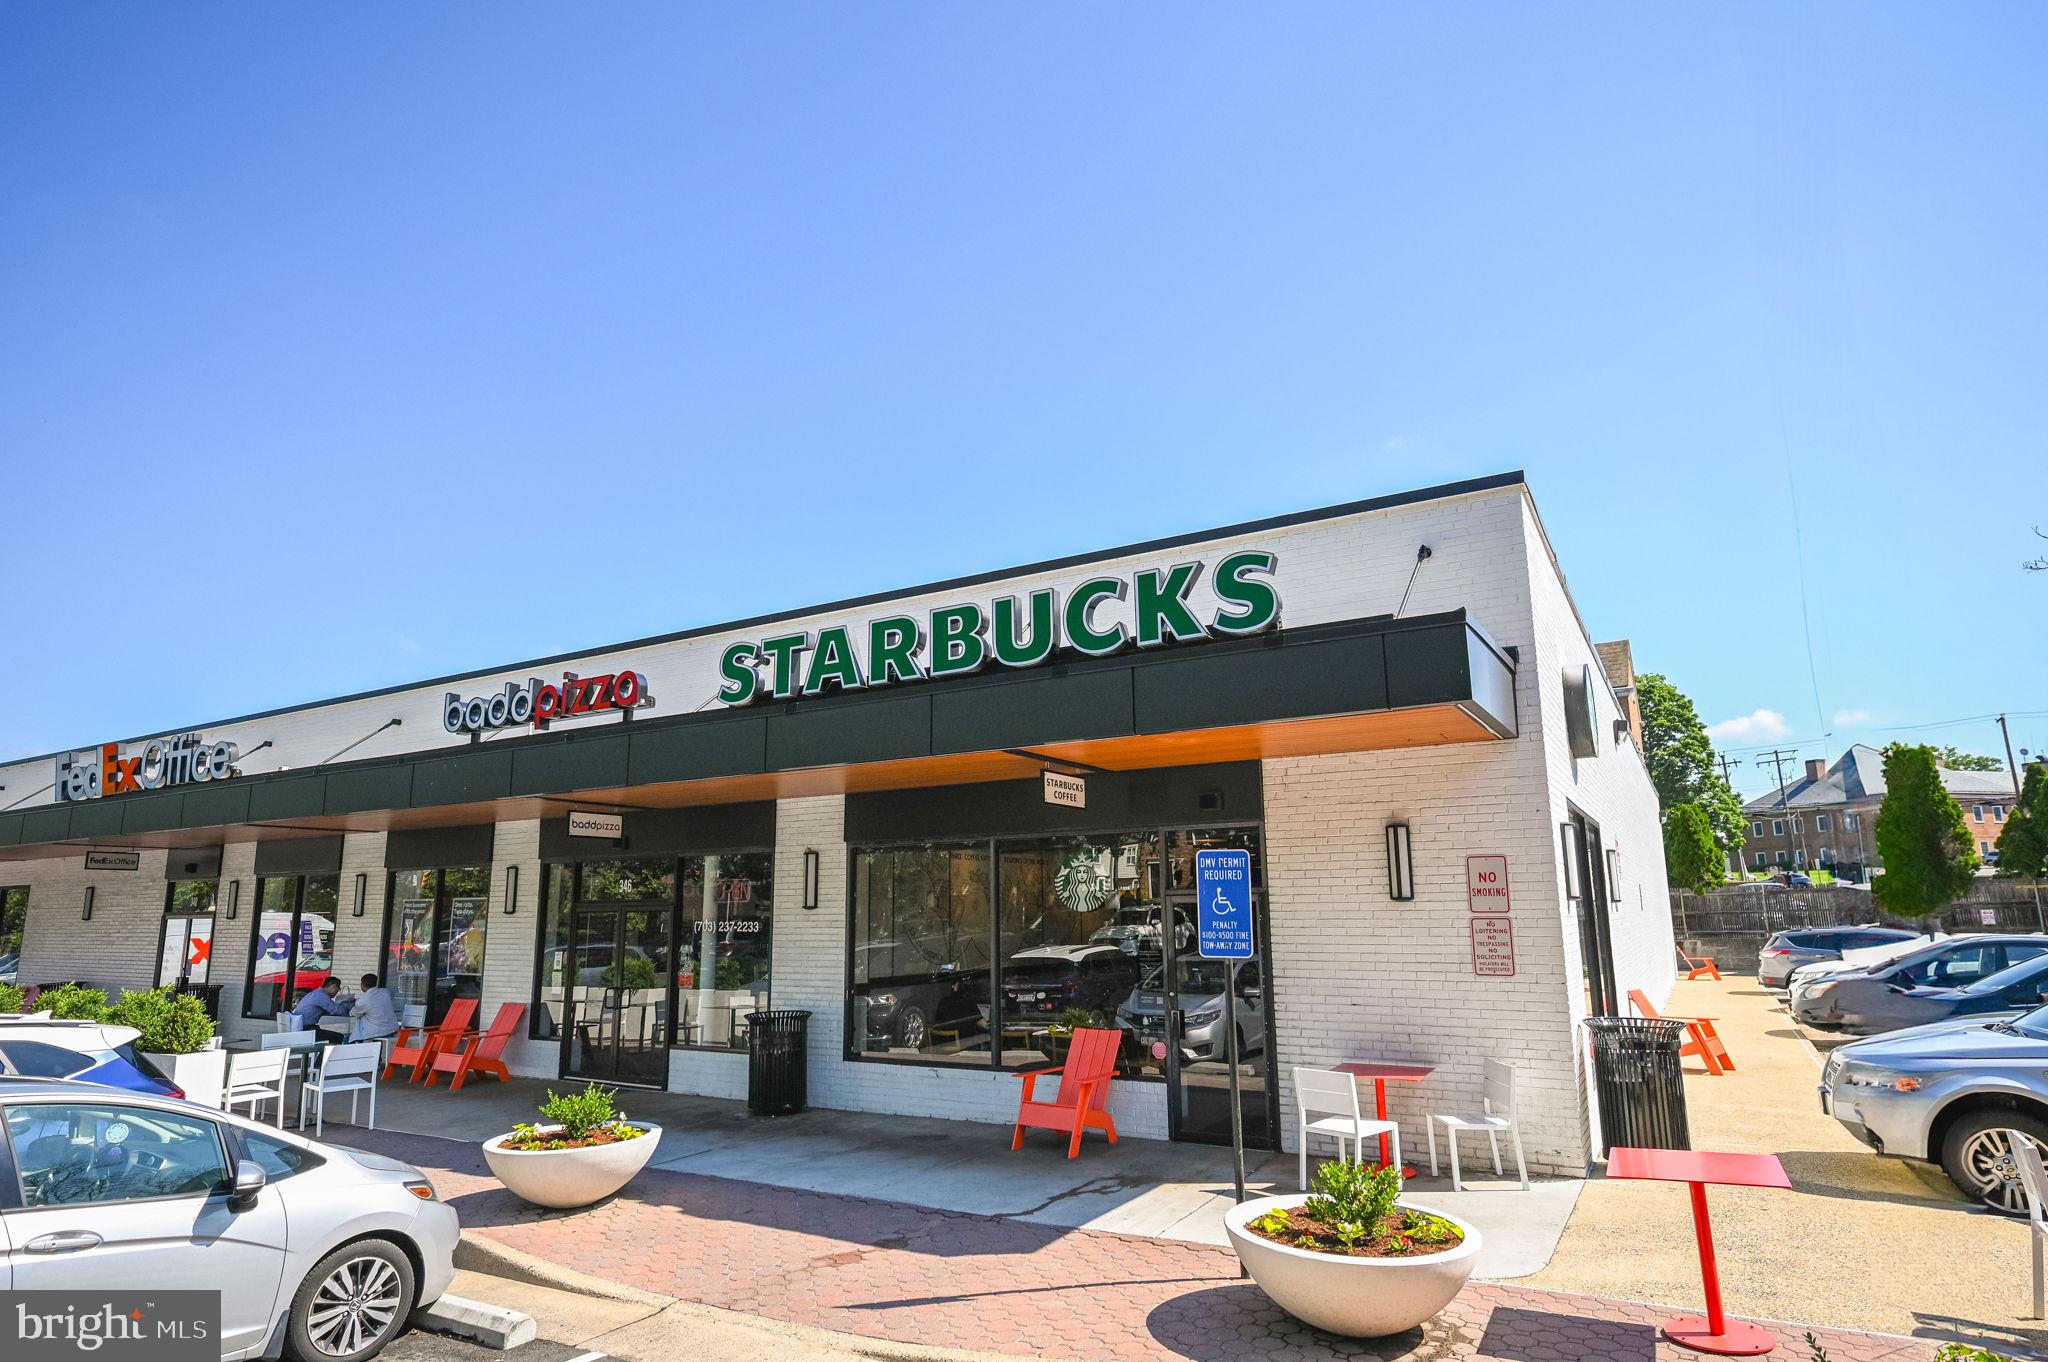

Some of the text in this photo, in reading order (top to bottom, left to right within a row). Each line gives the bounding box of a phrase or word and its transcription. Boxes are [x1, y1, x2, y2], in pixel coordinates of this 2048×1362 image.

[718, 550, 1281, 706] STARBUCKS
[444, 670, 643, 732] baddpizza
[55, 734, 236, 802] FedEx Office
[1046, 778, 1084, 793] STARBUCKS
[1053, 790, 1077, 802] COFFEE
[571, 819, 621, 832] baddpizza
[1200, 857, 1216, 868] DMV
[1204, 869, 1243, 880] REQUIRED
[1478, 871, 1497, 883] NO
[619, 879, 632, 893] 346
[1471, 887, 1506, 897] SMOKING
[693, 920, 760, 934] (703) 237-2233
[1212, 921, 1238, 930] PENALTY
[1201, 931, 1250, 940] $100-$500 FINE
[1202, 941, 1250, 950] TOW-AWAY ZONE
